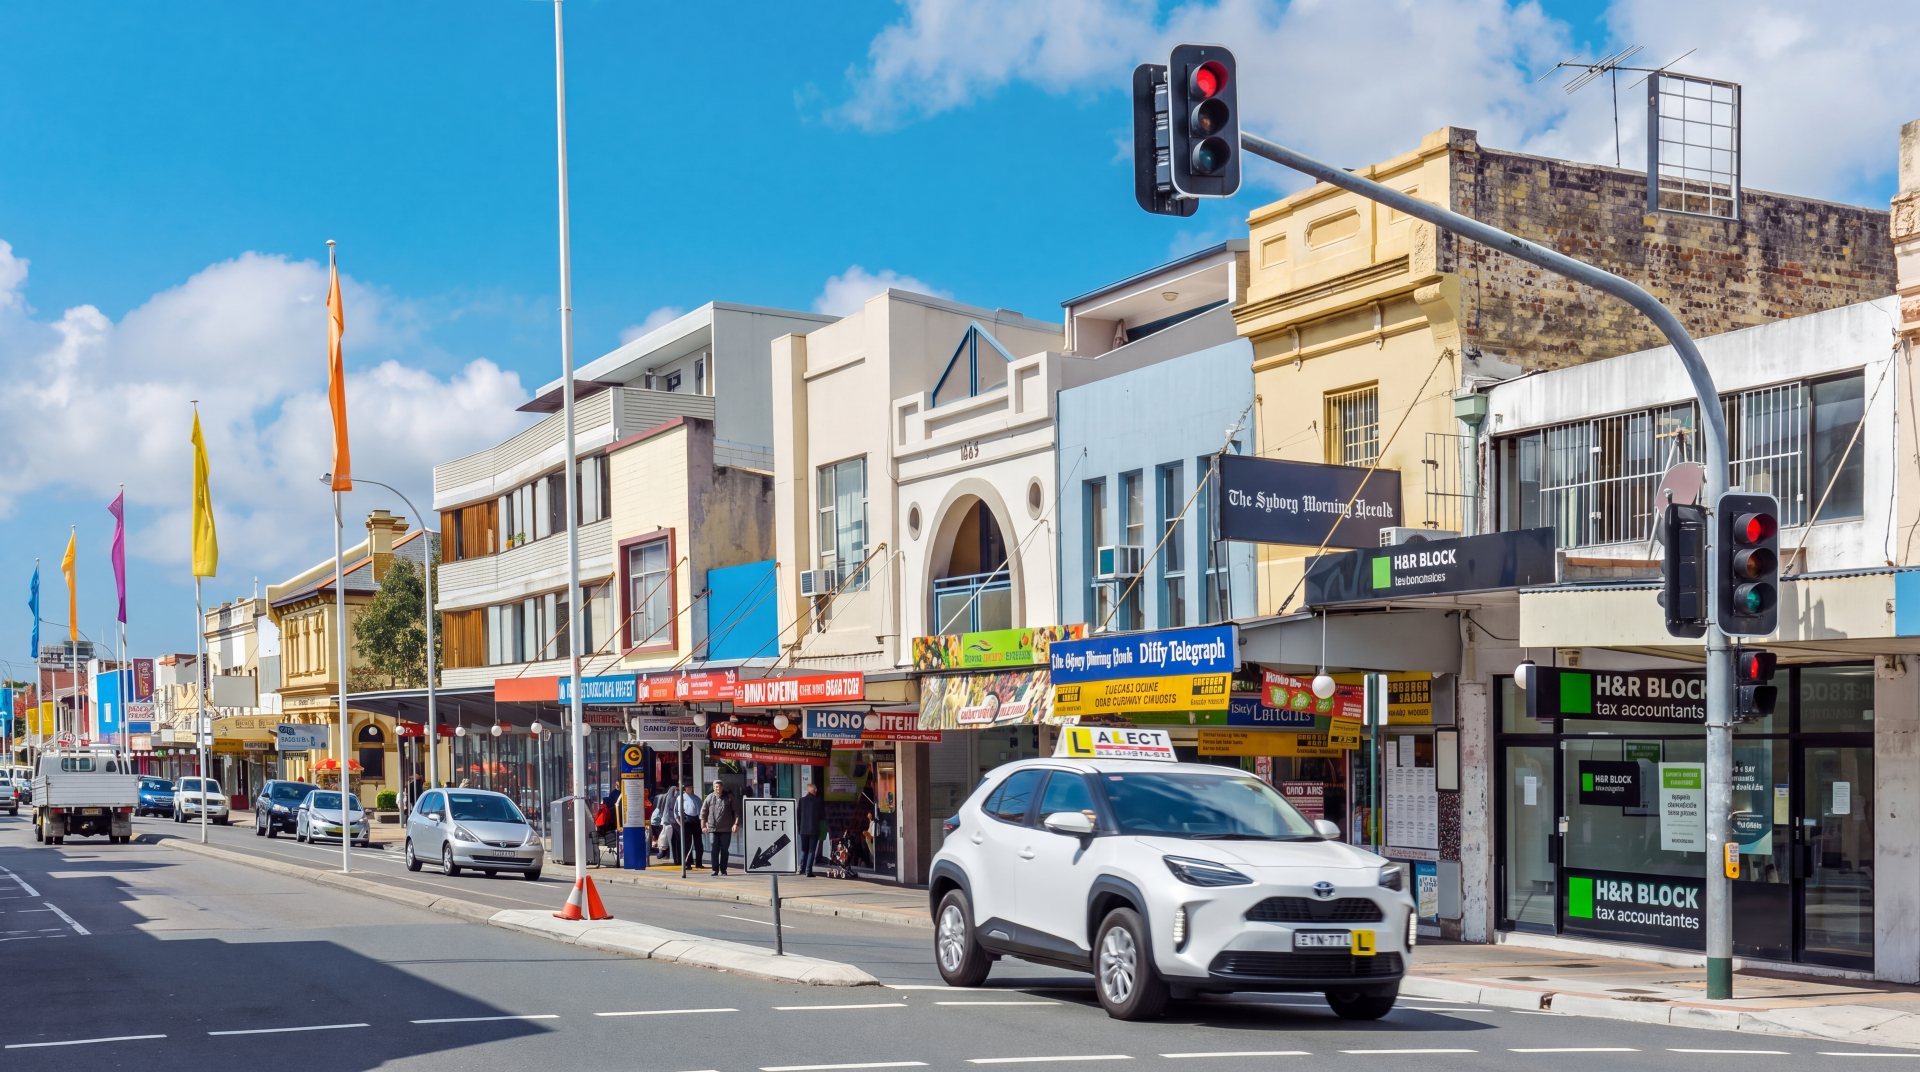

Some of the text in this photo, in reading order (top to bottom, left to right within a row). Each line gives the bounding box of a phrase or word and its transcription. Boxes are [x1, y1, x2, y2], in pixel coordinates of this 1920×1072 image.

[1228, 489, 1252, 508] The
[1302, 495, 1352, 520] Morning
[1394, 548, 1457, 570] H&R BLOCK
[1139, 641, 1169, 668] Diffy
[1169, 636, 1226, 667] Telegraph
[1596, 674, 1641, 697] H&R
[1596, 701, 1705, 719] tax accountants
[816, 712, 862, 729] HONO
[1071, 730, 1092, 753] L
[1097, 730, 1162, 746] ALECT
[1609, 775, 1632, 784] BLOCK
[753, 805, 787, 817] KEEP
[755, 820, 787, 831] LEFT
[1596, 879, 1699, 910] H&R BLOCK
[1596, 905, 1699, 930] tax accountantes
[1357, 933, 1372, 952] L
